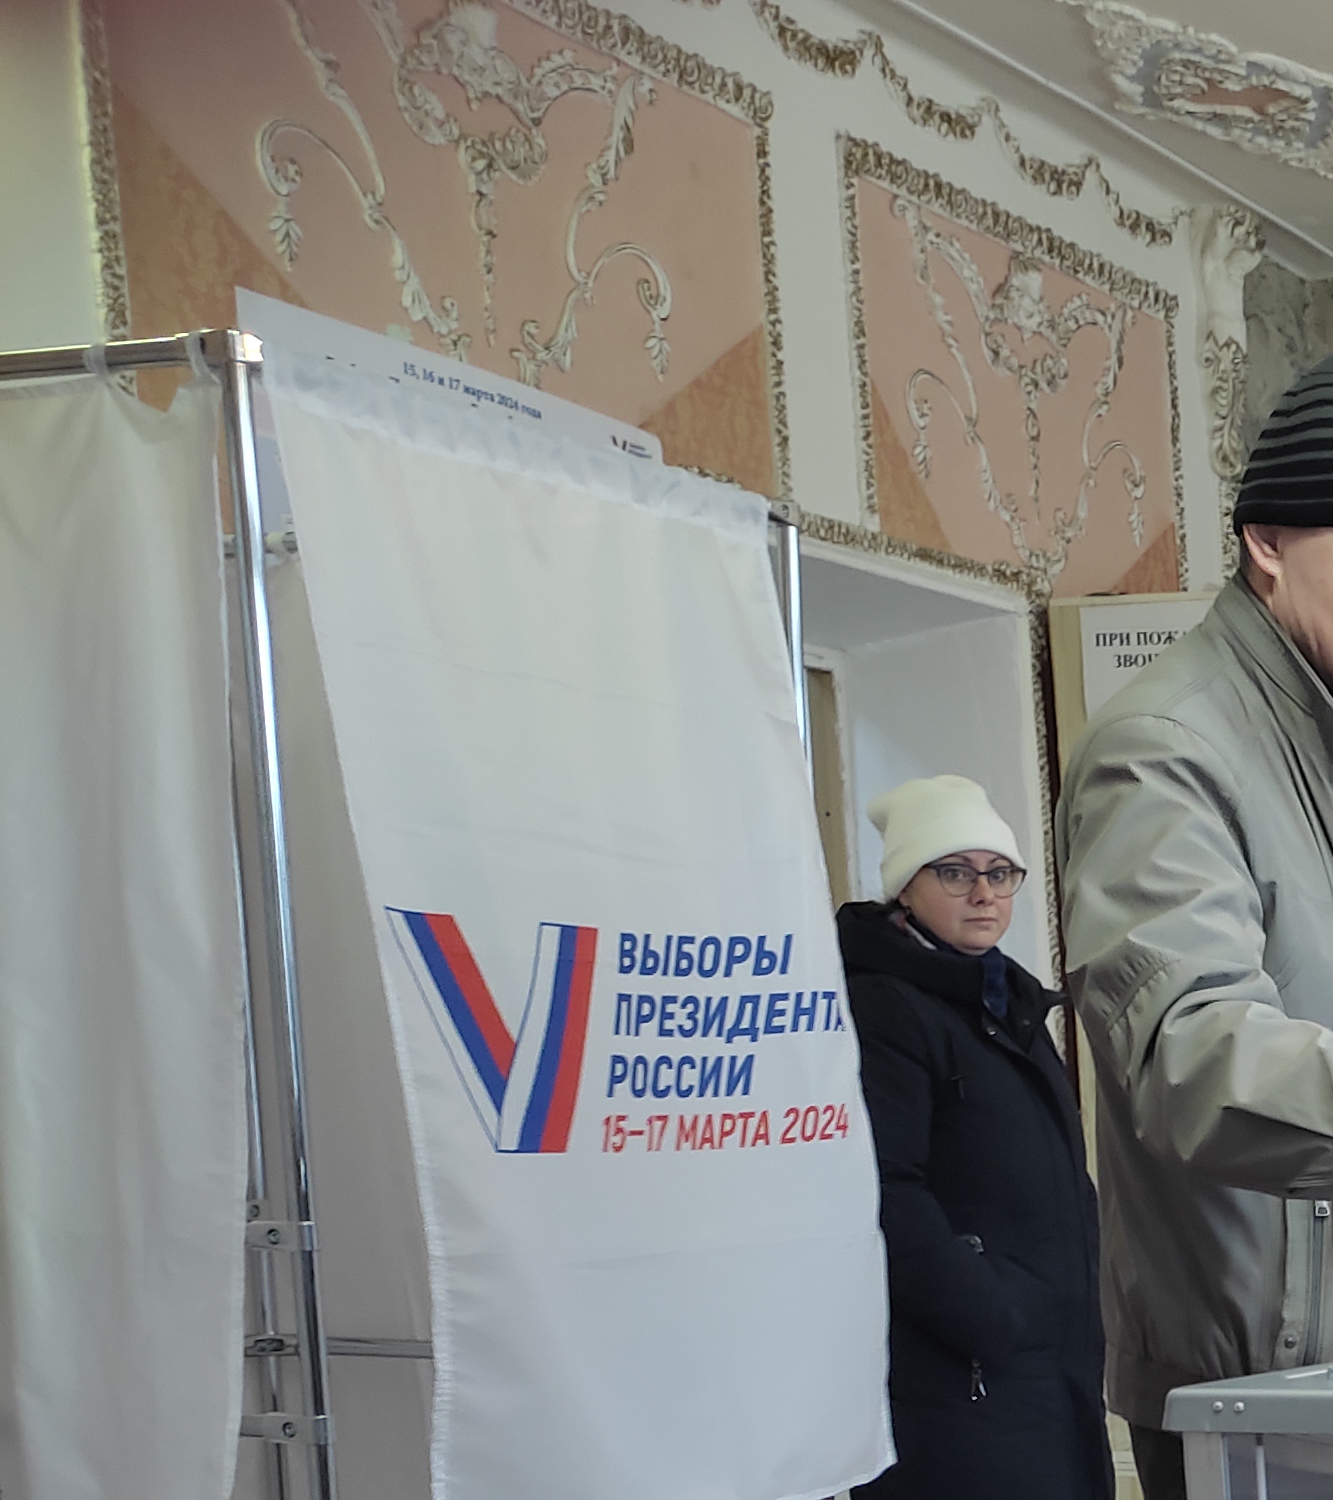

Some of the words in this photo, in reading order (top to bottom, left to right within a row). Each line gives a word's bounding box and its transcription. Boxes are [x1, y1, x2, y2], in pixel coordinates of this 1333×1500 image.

[403, 361, 420, 380] 15,
[422, 368, 435, 383] 16
[438, 375, 445, 386] и
[449, 376, 460, 391] 17
[463, 384, 495, 402] марта
[1095, 632, 1131, 647] ПРИ
[1136, 631, 1186, 646] ПОЖ
[617, 933, 794, 978] ВЫБОРЫ
[606, 1053, 755, 1099] РОССИИ
[675, 1110, 771, 1152] МАРТА
[779, 1104, 850, 1145] 2024
